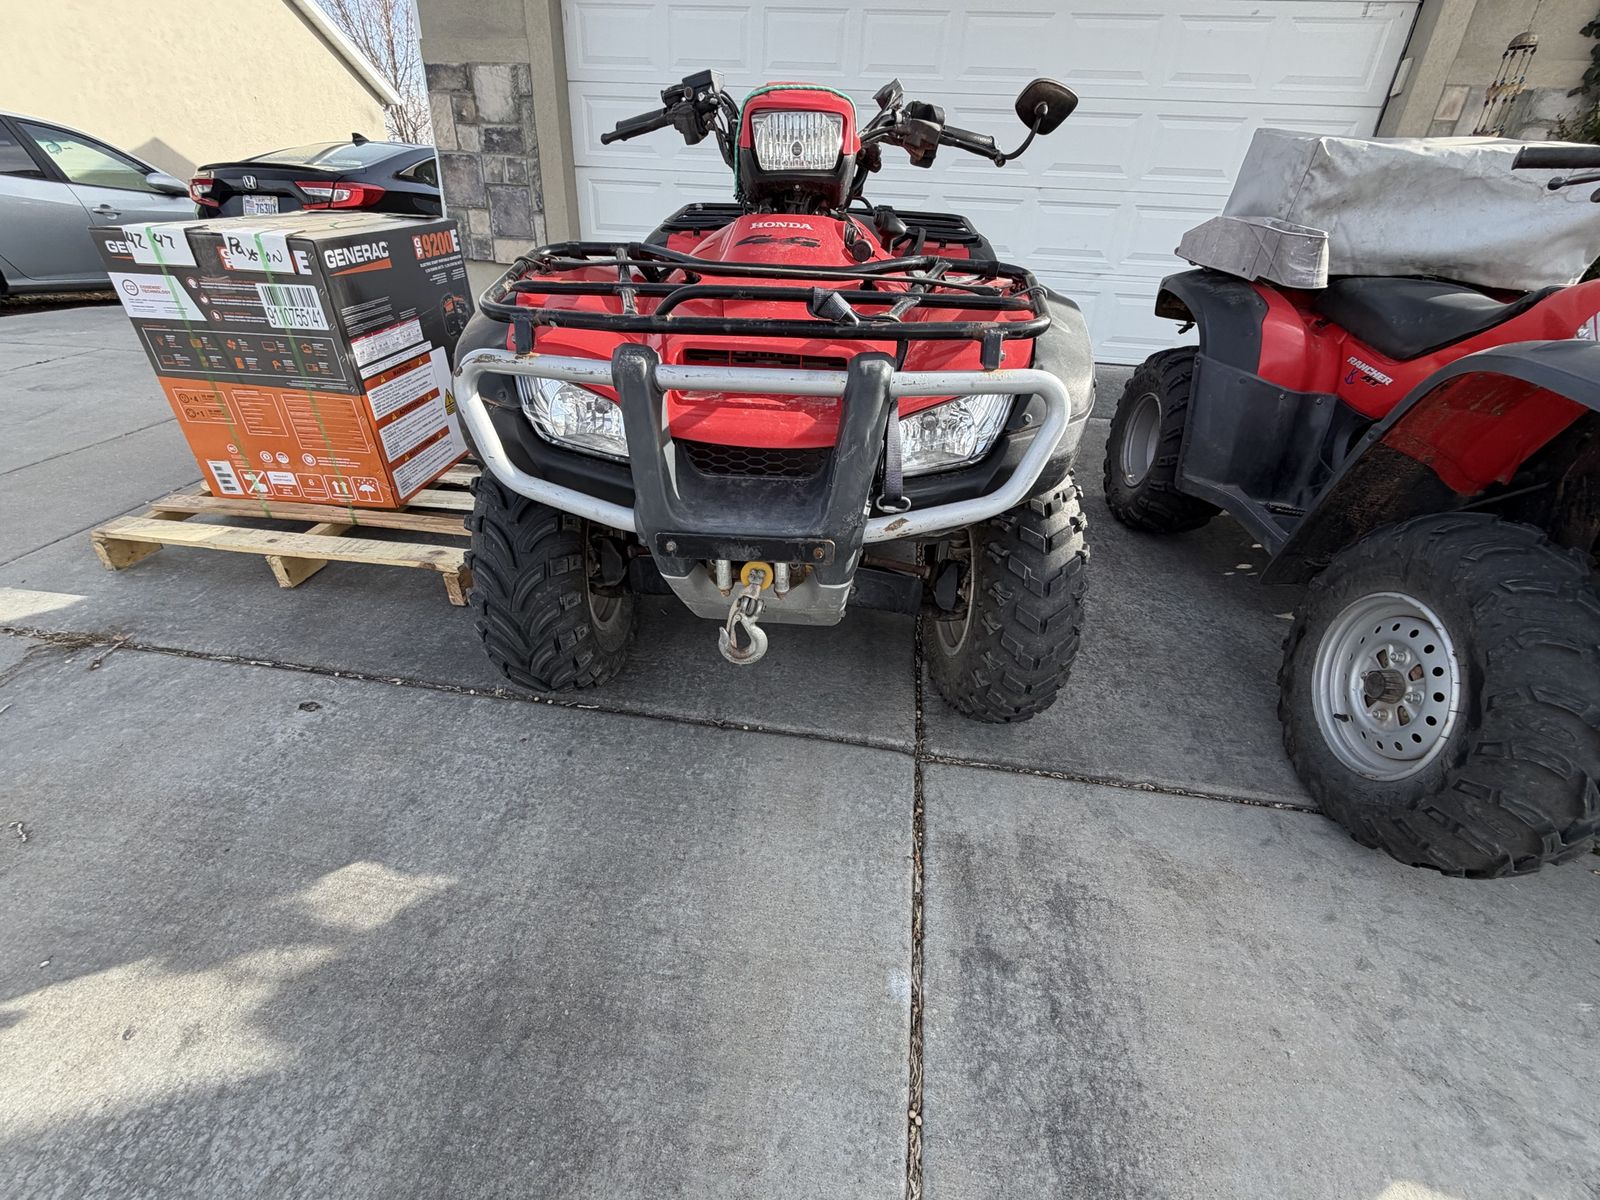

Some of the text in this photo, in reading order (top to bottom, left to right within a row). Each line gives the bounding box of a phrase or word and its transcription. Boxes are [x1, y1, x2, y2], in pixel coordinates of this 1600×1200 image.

[750, 221, 813, 230] HONDA
[323, 241, 389, 268] GENERAC
[266, 306, 325, 327] 9110755141
[1347, 356, 1393, 385] RANCHER
